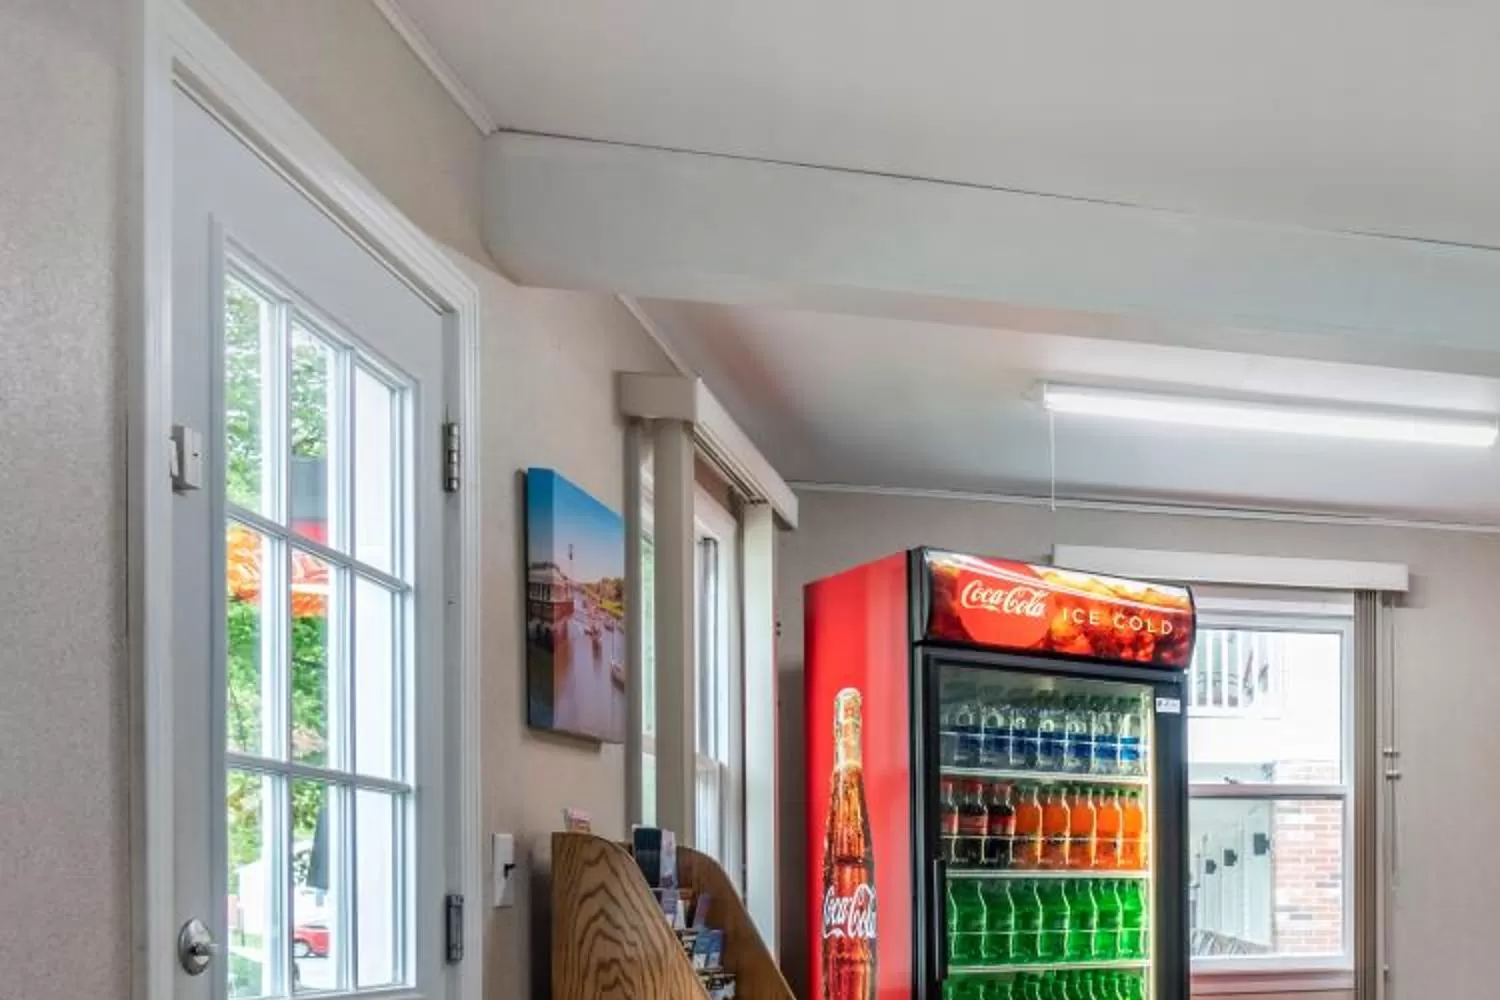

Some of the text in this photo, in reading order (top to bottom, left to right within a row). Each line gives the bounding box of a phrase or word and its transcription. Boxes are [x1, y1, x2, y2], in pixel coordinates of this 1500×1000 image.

[961, 579, 1050, 617] Coca-Cola
[1063, 607, 1174, 635] ICE COLD
